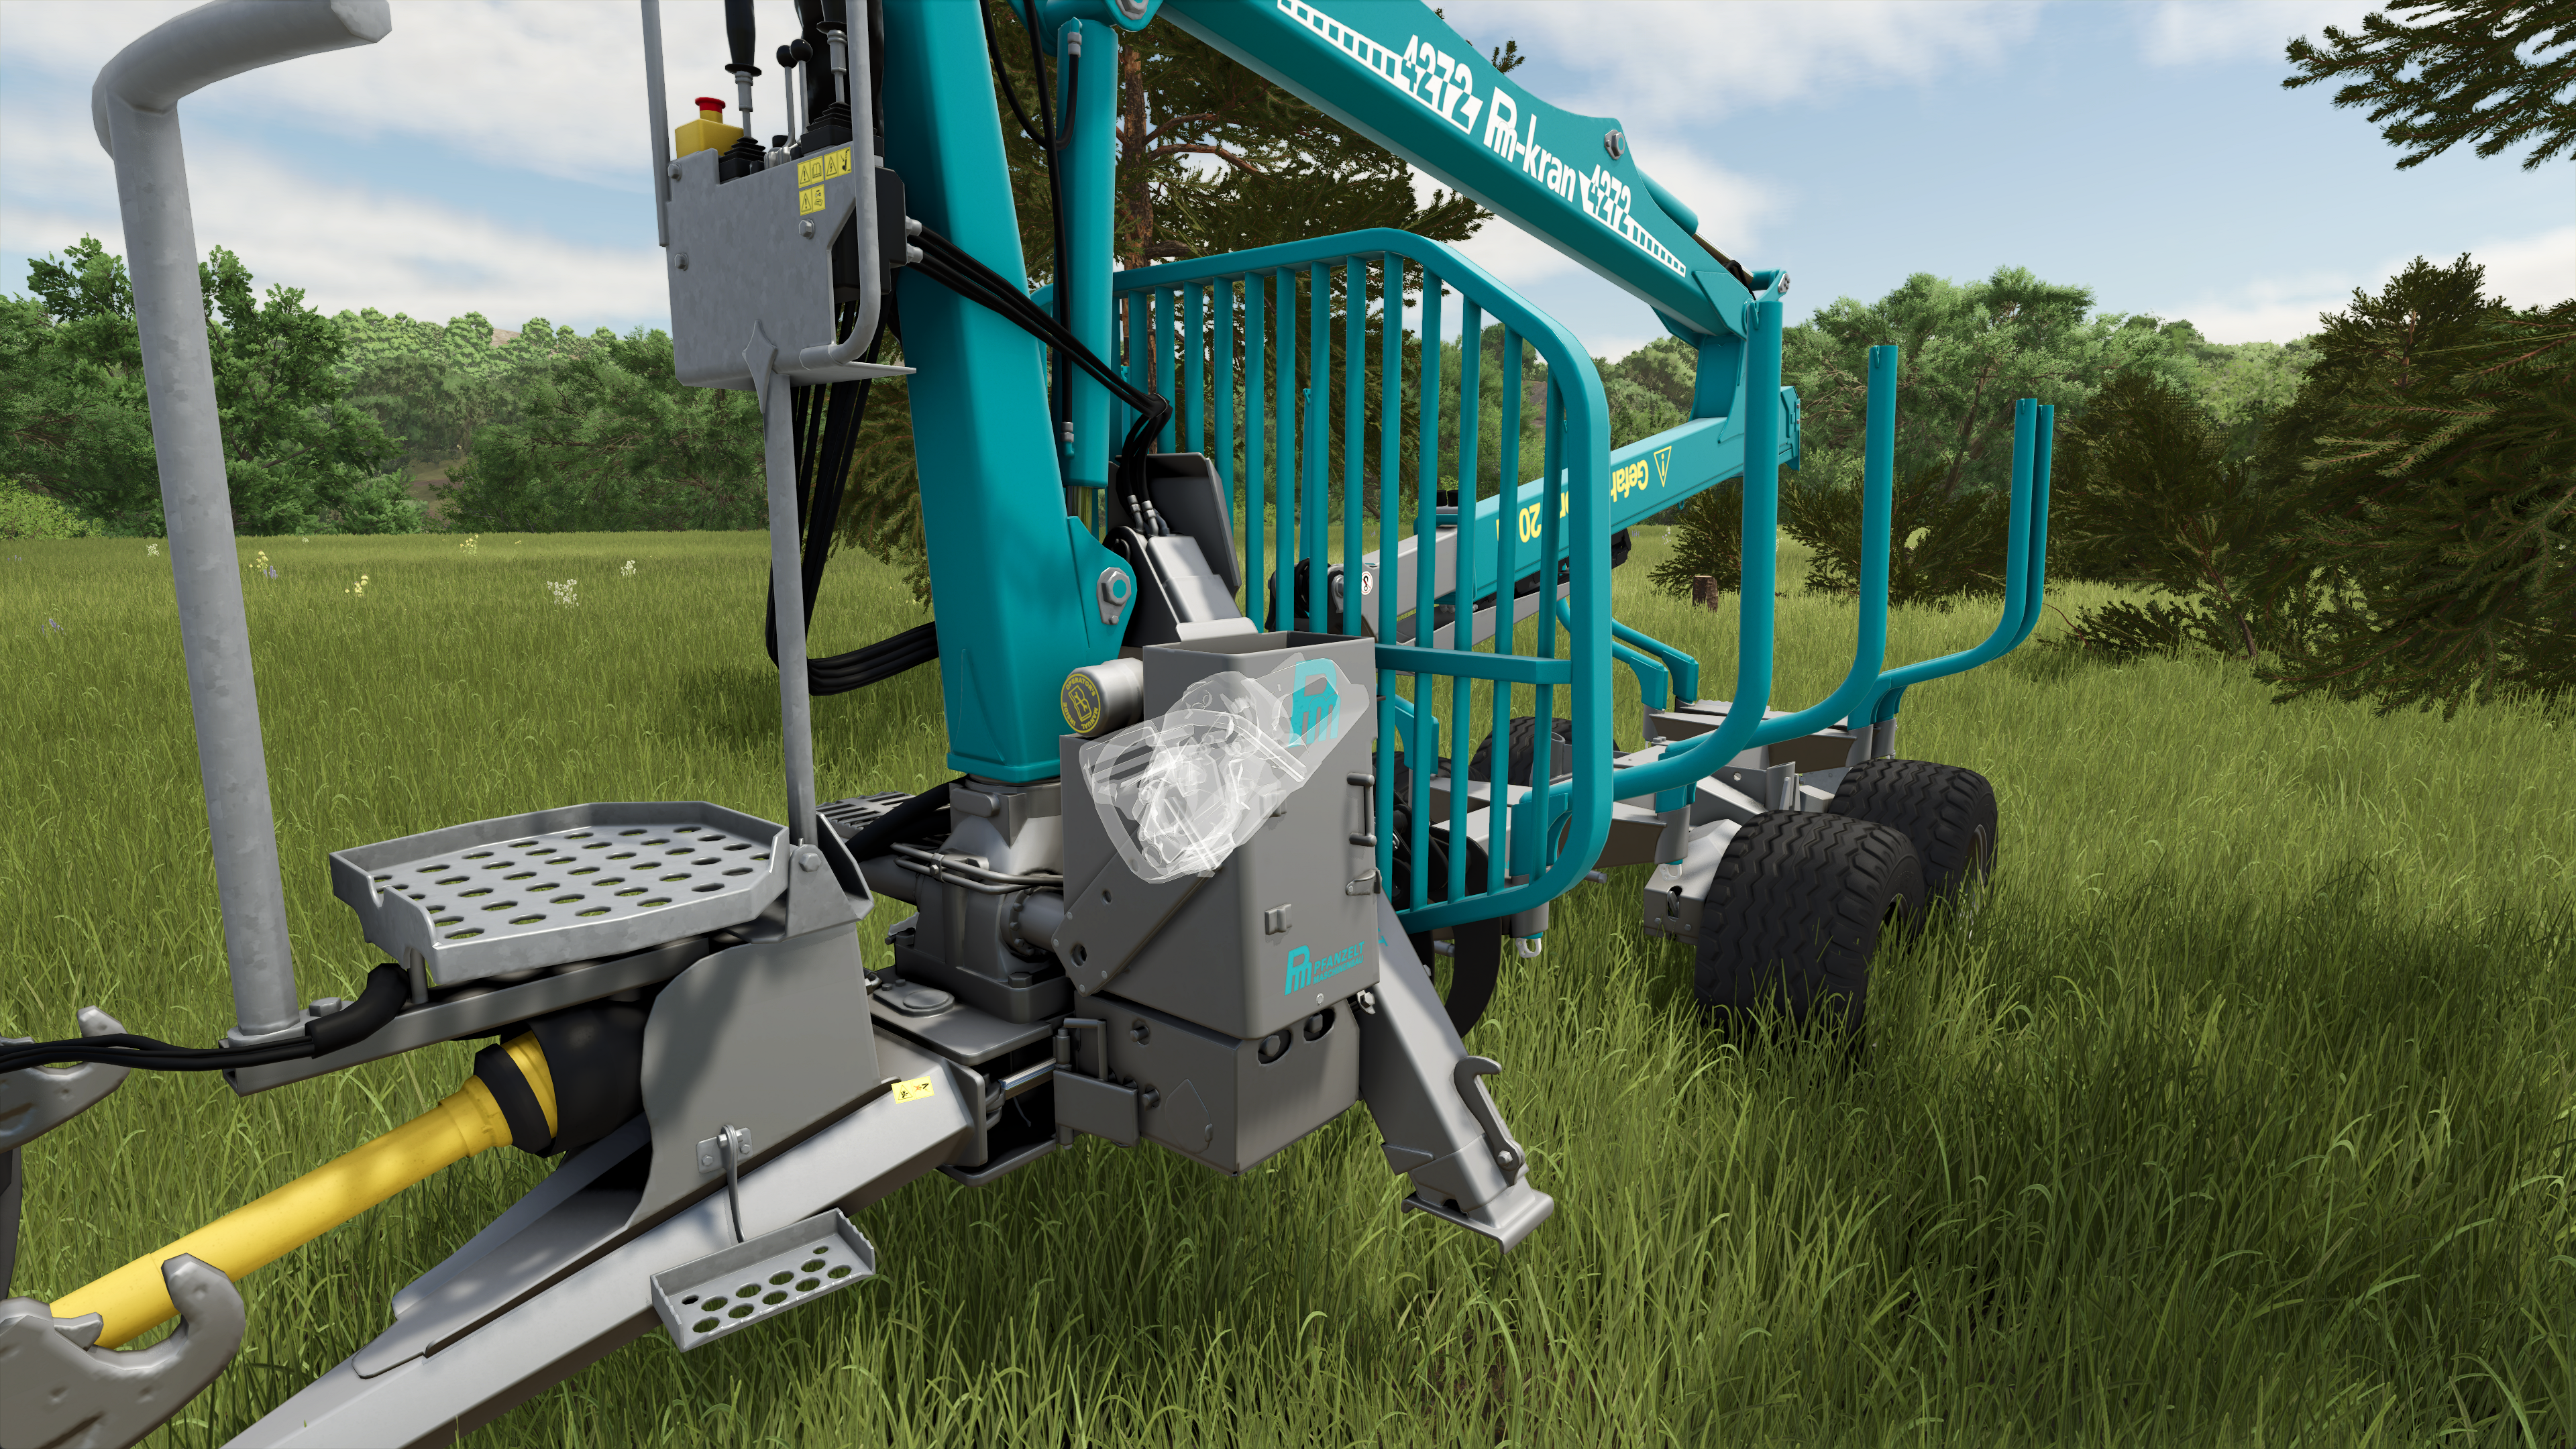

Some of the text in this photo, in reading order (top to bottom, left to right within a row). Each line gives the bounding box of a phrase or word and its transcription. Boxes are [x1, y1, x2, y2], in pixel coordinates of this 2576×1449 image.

[1401, 34, 1631, 236] 4272 Pm-kran 4272
[1518, 502, 1542, 543] 20
[1063, 677, 1098, 730] OPERATOR'S MANUAL INSIDE
[1313, 955, 1364, 985] MASCHINENBAU
[1314, 941, 1365, 975] PFANZELT
